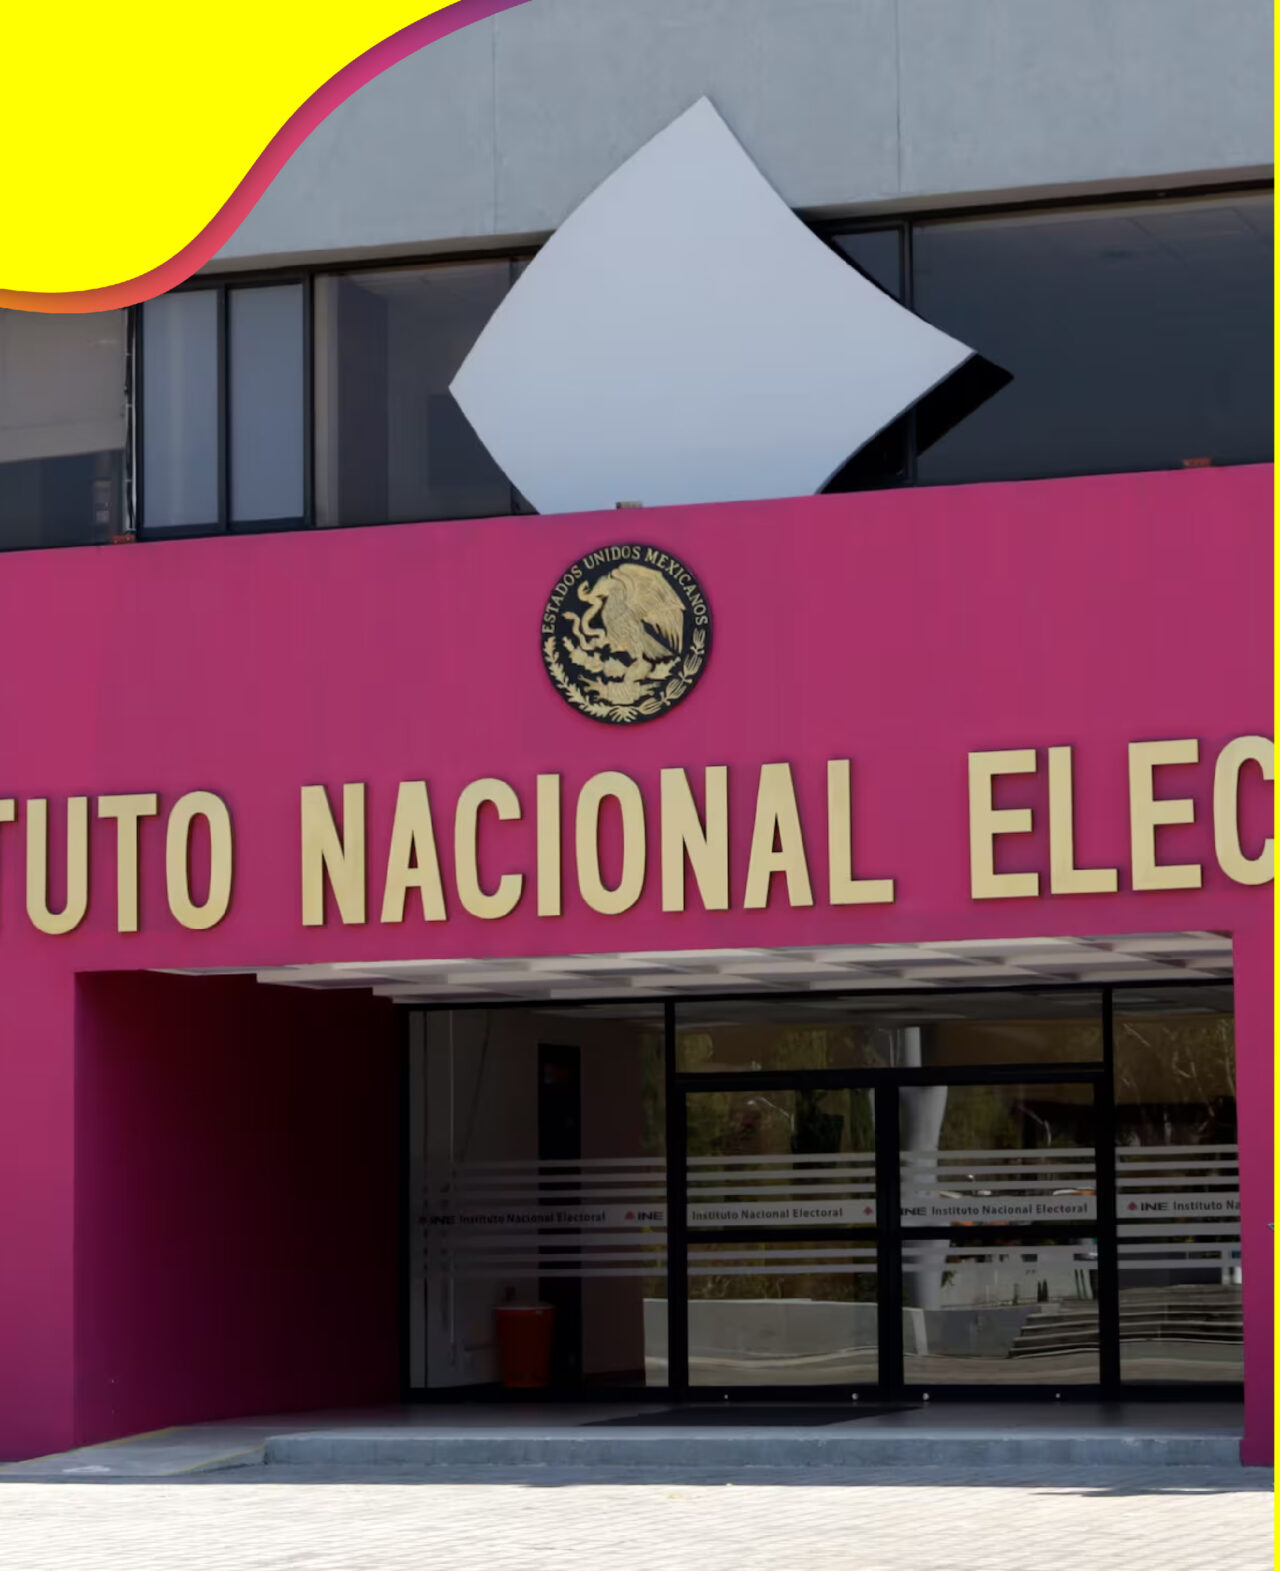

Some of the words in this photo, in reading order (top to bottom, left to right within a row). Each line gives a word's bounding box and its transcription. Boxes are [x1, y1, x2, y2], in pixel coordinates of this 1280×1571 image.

[542, 565, 583, 634] ESTADOS
[583, 545, 641, 569] UNIDOS
[644, 547, 708, 626] MEXICANOS
[0, 790, 232, 934] UTO
[301, 759, 894, 926] NACIONAL
[968, 735, 1274, 900] ELEC
[932, 1205, 980, 1216] Instituto
[982, 1204, 1033, 1215] Nacional
[1036, 1202, 1088, 1214] Electoral
[1140, 1201, 1168, 1211] INE
[1173, 1200, 1223, 1211] Instituto
[637, 1210, 665, 1221] INE
[692, 1210, 739, 1221] Instituto
[741, 1208, 790, 1220] Nacional
[793, 1207, 843, 1218] Electoral
